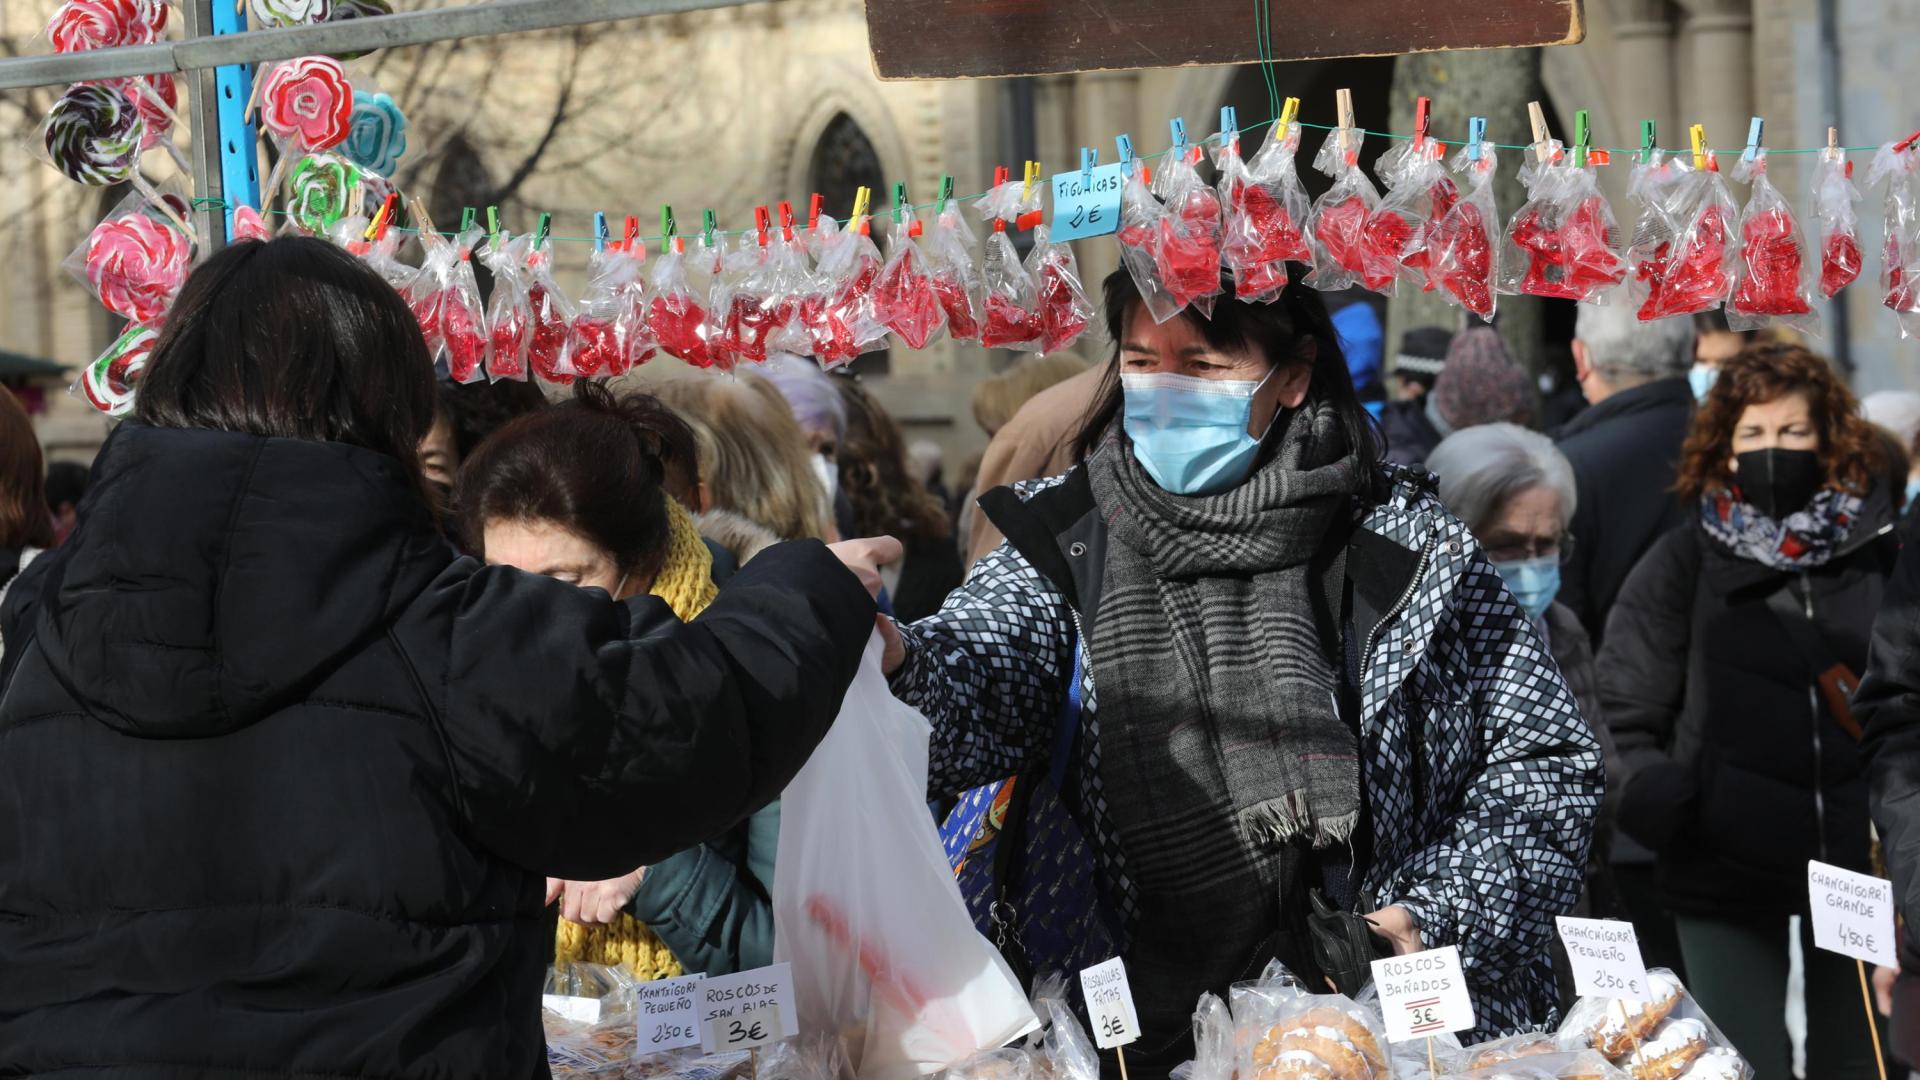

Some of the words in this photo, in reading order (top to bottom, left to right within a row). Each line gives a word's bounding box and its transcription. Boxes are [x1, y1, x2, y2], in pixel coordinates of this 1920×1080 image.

[1826, 893, 1874, 918] GRANDE
[1568, 941, 1625, 962] PEQUEÑO
[1383, 956, 1446, 977] ROSCOS
[706, 984, 761, 1002] ROSCOS
[763, 984, 778, 994] DE
[1385, 978, 1451, 997] BAÑADOS
[644, 997, 692, 1014] PEQUEÑO
[704, 1006, 734, 1021] SAN
[728, 1020, 768, 1043] 3€
[1102, 1014, 1125, 1037] 3€
